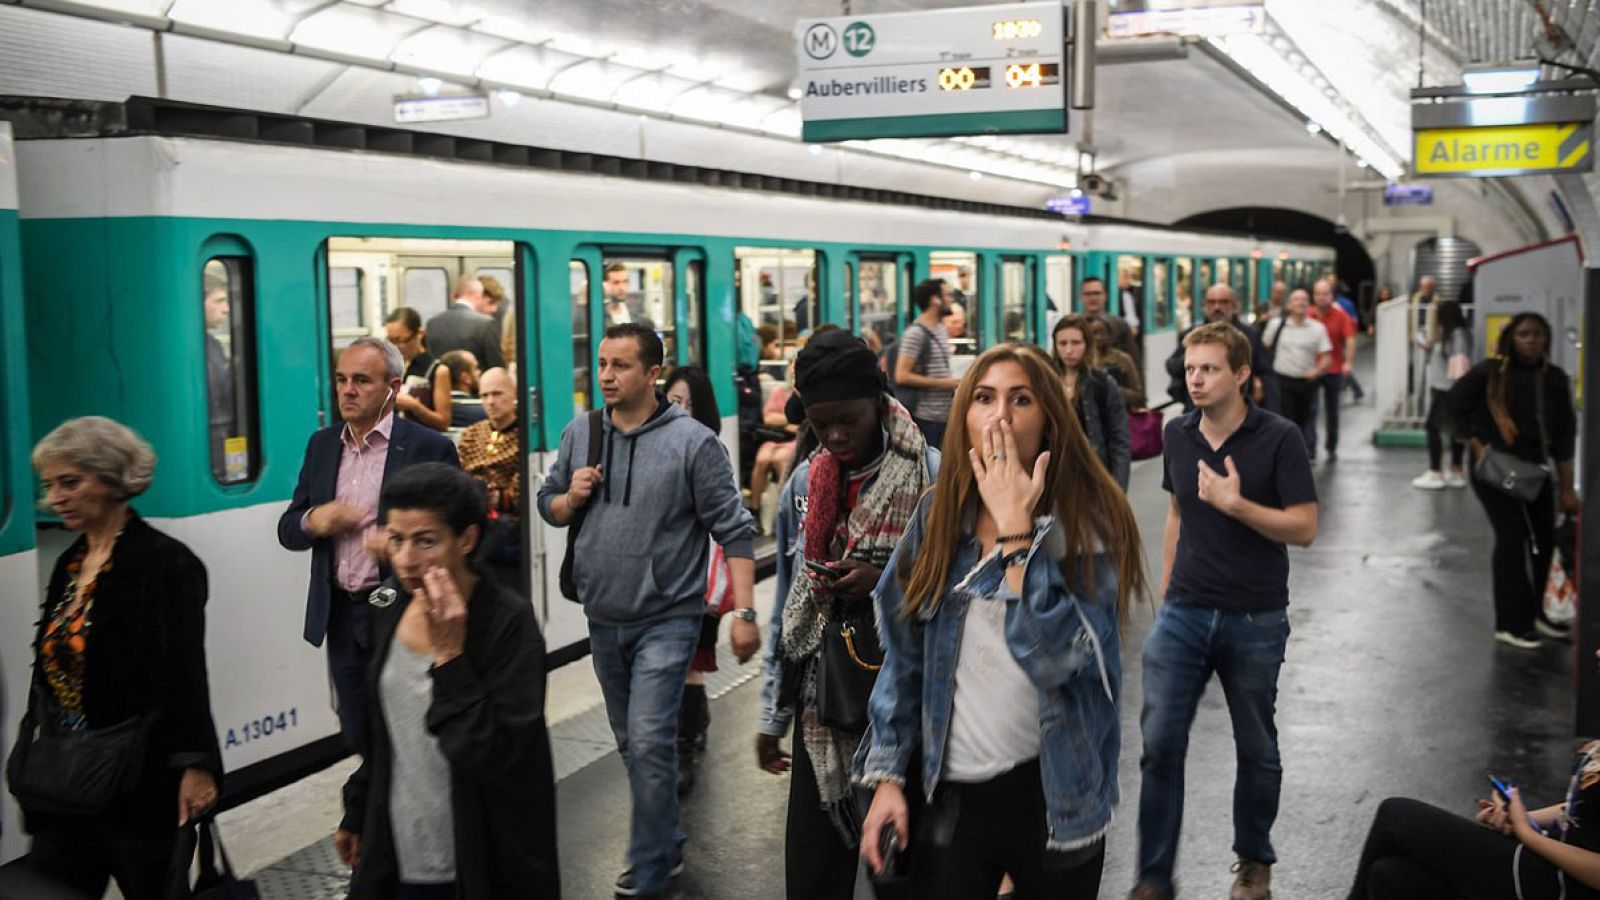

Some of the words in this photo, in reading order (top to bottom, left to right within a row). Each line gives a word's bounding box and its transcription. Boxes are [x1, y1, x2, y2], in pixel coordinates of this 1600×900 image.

[811, 32, 831, 51] M
[845, 28, 872, 51] 12
[805, 76, 927, 98] Aubervilliers
[938, 66, 975, 91] 00
[1005, 63, 1041, 88] 04
[1429, 139, 1541, 164] Alarme
[225, 707, 298, 750] A.13041
